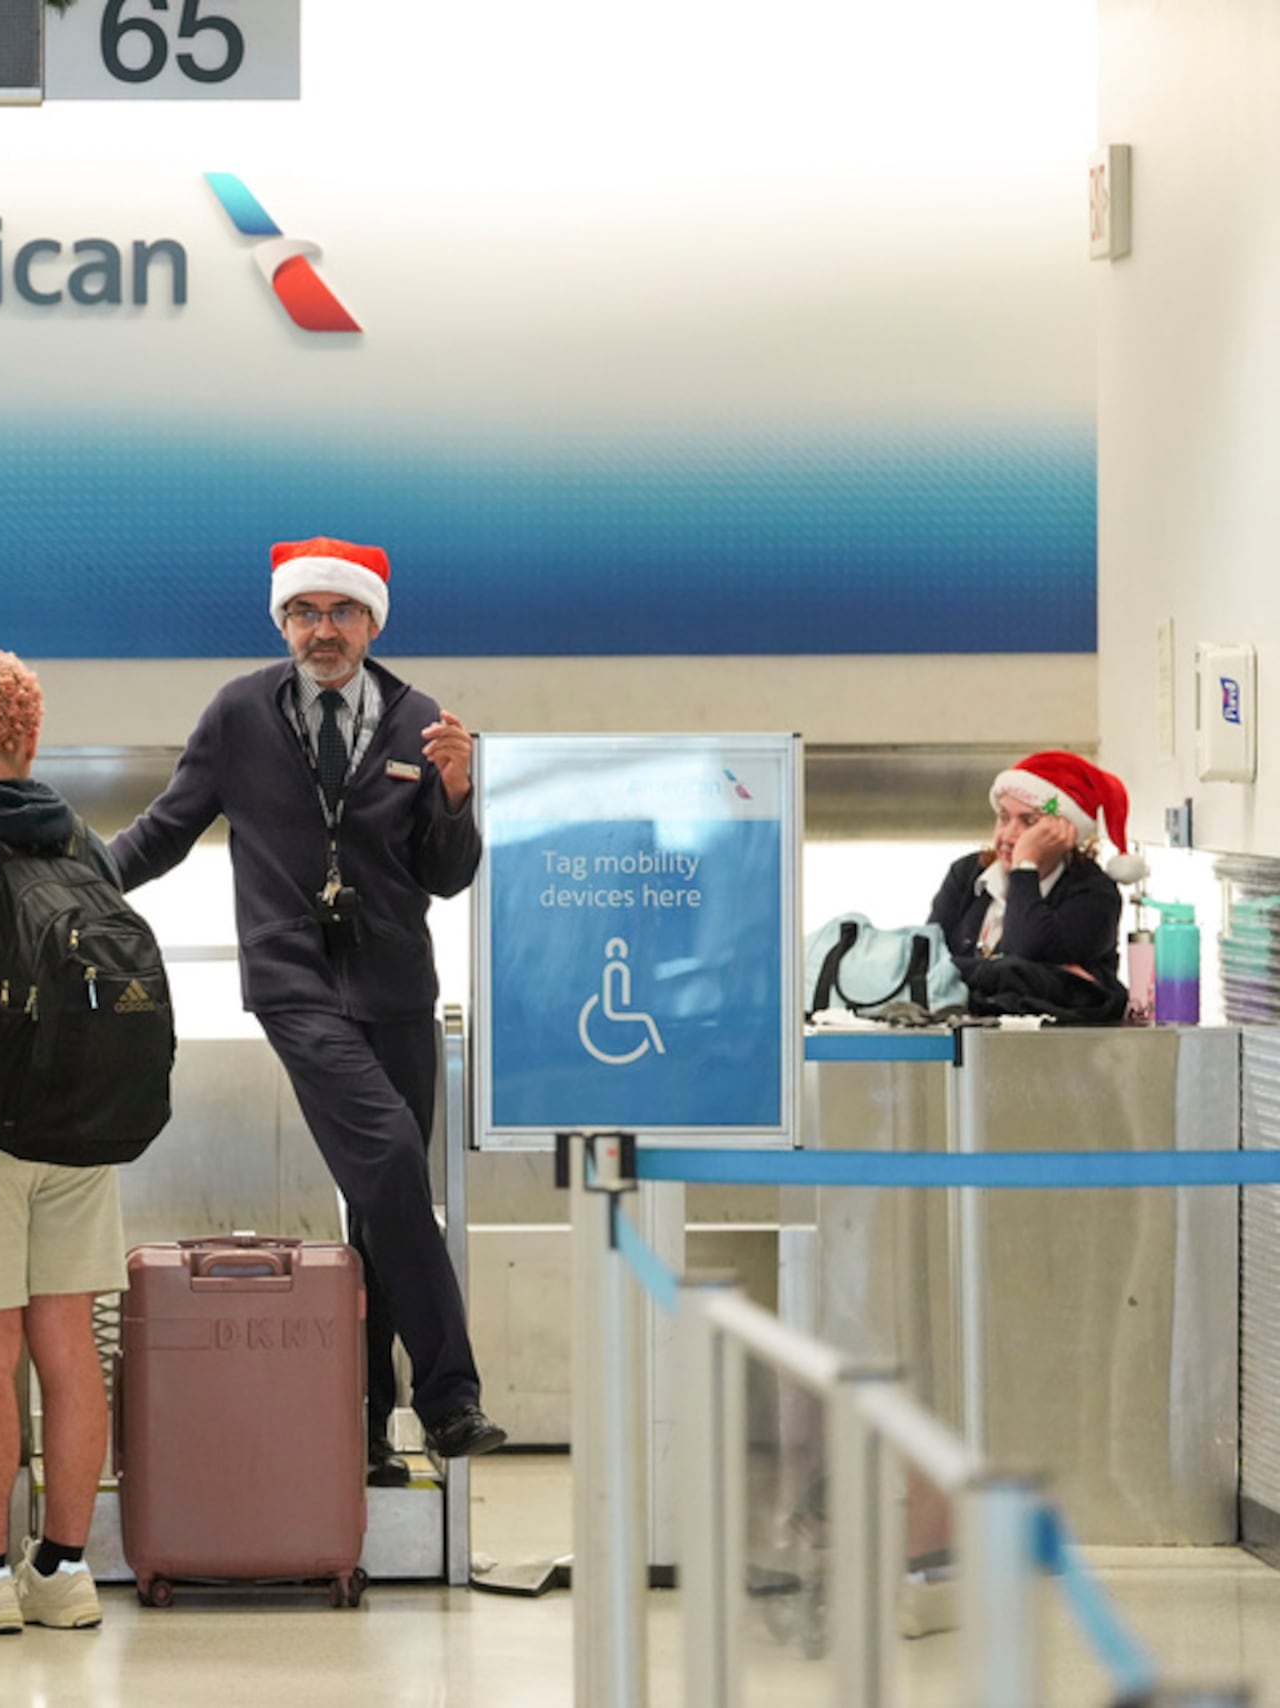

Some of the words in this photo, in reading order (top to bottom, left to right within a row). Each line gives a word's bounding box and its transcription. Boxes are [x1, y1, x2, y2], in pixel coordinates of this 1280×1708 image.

[100, 0, 245, 83] 65
[542, 850, 588, 881] Tag
[594, 850, 700, 881] mobility
[539, 884, 635, 908] devices
[642, 883, 702, 908] here
[214, 1317, 337, 1349] DKNY
